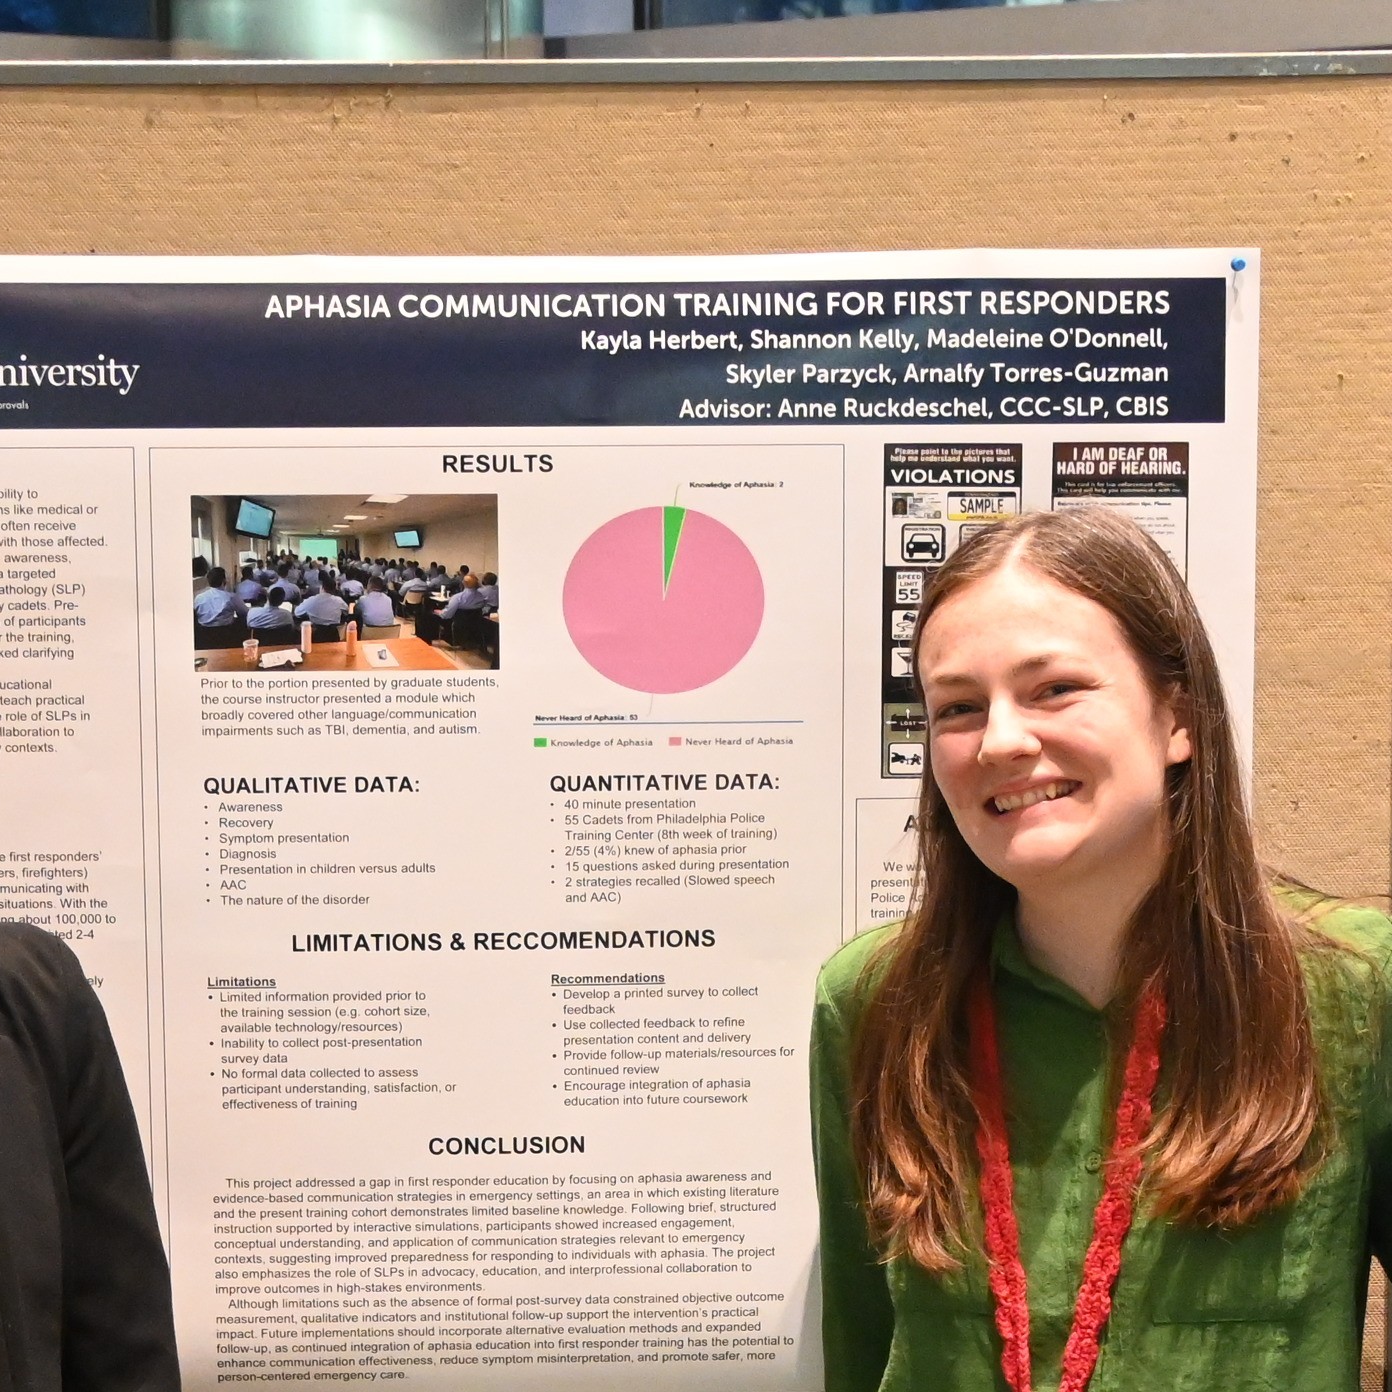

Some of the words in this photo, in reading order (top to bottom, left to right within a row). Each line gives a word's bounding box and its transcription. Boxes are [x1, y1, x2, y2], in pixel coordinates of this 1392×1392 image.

[265, 294, 391, 318] APHASIA
[398, 293, 664, 318] COMMUNICATION
[674, 292, 817, 316] TRAINING
[828, 292, 884, 315] FOR
[894, 291, 972, 314] FIRST
[981, 290, 1170, 314] RESPONDERS
[582, 330, 642, 354] Kayla
[650, 330, 742, 352] Herbert,
[751, 330, 851, 348] Shannon
[860, 328, 919, 353] Kelly,
[928, 328, 1043, 348] Madeleine
[1050, 328, 1168, 350] O'Donnell,
[726, 364, 796, 388] Skyler
[803, 364, 896, 388] Parzyck,
[904, 363, 984, 387] Arnalfy
[990, 362, 1168, 383] Torres-Guzman
[679, 399, 770, 418] Advisor:
[778, 398, 836, 418] Anne
[844, 397, 992, 420] Ruckdeschel,
[1000, 397, 1108, 420] CCC-SLP,
[1116, 396, 1168, 416] CBIS
[1073, 447, 1077, 460] I
[1081, 447, 1104, 460] AM
[1109, 447, 1144, 460] DEAF
[1149, 447, 1167, 460] OR
[443, 453, 553, 473] RESULTS
[1057, 461, 1094, 475] HARD
[1099, 461, 1116, 475] OF
[1121, 460, 1187, 475] HEARING.
[890, 468, 1016, 484] VIOLATIONS
[689, 481, 732, 489] Knowledge
[27, 489, 38, 499] to
[959, 498, 1005, 514] SAMPLE
[898, 588, 921, 601] 55
[200, 678, 228, 689] Prior
[232, 679, 243, 689] to
[246, 678, 265, 689] the
[268, 678, 308, 691] portion
[312, 678, 370, 691] presented
[373, 677, 387, 691] by
[391, 677, 443, 690] graduate
[446, 676, 499, 689] students,
[200, 694, 219, 705] the
[222, 695, 262, 704] course
[266, 694, 320, 704] instructor
[323, 693, 380, 706] presented
[384, 695, 392, 703] a
[395, 693, 439, 703] module
[442, 692, 475, 702] which
[535, 714, 558, 722] Never
[550, 738, 601, 748] Knowledge
[604, 738, 614, 746] of
[617, 738, 654, 748] Aphasia
[686, 737, 712, 746] Never
[714, 737, 743, 746] Heard
[745, 737, 754, 745] of
[757, 736, 794, 746] Aphasia
[203, 776, 347, 796] QUALITATIVE
[354, 775, 420, 793] DATA:
[549, 773, 708, 793] QUANTITATIVE
[715, 773, 780, 791] DATA:
[218, 802, 283, 812] Awareness
[564, 799, 579, 810] 40
[582, 799, 622, 809] minute
[625, 798, 696, 811] presentation
[219, 817, 274, 830] Recovery
[564, 815, 579, 825] 55
[582, 814, 624, 825] Cadets
[627, 814, 653, 824] from
[656, 813, 727, 826] Philadelphia
[730, 812, 765, 823] Police
[219, 833, 274, 846] Symptom
[277, 832, 350, 845] presentation
[219, 848, 277, 861] Diagnosis
[219, 864, 293, 875] Presentation
[296, 864, 307, 874] in
[310, 863, 356, 874] children
[359, 865, 398, 874] versus
[401, 863, 436, 874] adults
[220, 879, 247, 891] AAC
[291, 932, 443, 953] LIMITATIONS
[449, 932, 467, 951] &
[473, 929, 716, 951] RECCOMENDATIONS
[207, 976, 277, 988] Limitations
[551, 972, 665, 985] Recommendations
[219, 991, 262, 1002] Limited
[265, 991, 329, 1002] information
[332, 990, 382, 1004] provided
[385, 990, 412, 1003] prior
[415, 990, 427, 1001] to
[563, 988, 611, 1001] Develop
[613, 990, 621, 998] a
[624, 987, 663, 1000] printed
[666, 989, 705, 999] survey
[707, 987, 719, 997] to
[722, 986, 759, 997] collect
[428, 1135, 585, 1156] CONCLUSION
[225, 1177, 251, 1189] This
[253, 1177, 293, 1191] project
[295, 1177, 356, 1188] addressed
[359, 1179, 366, 1188] a
[369, 1178, 391, 1191] gap
[394, 1176, 405, 1187] in
[408, 1176, 430, 1187] first
[432, 1176, 490, 1188] responder
